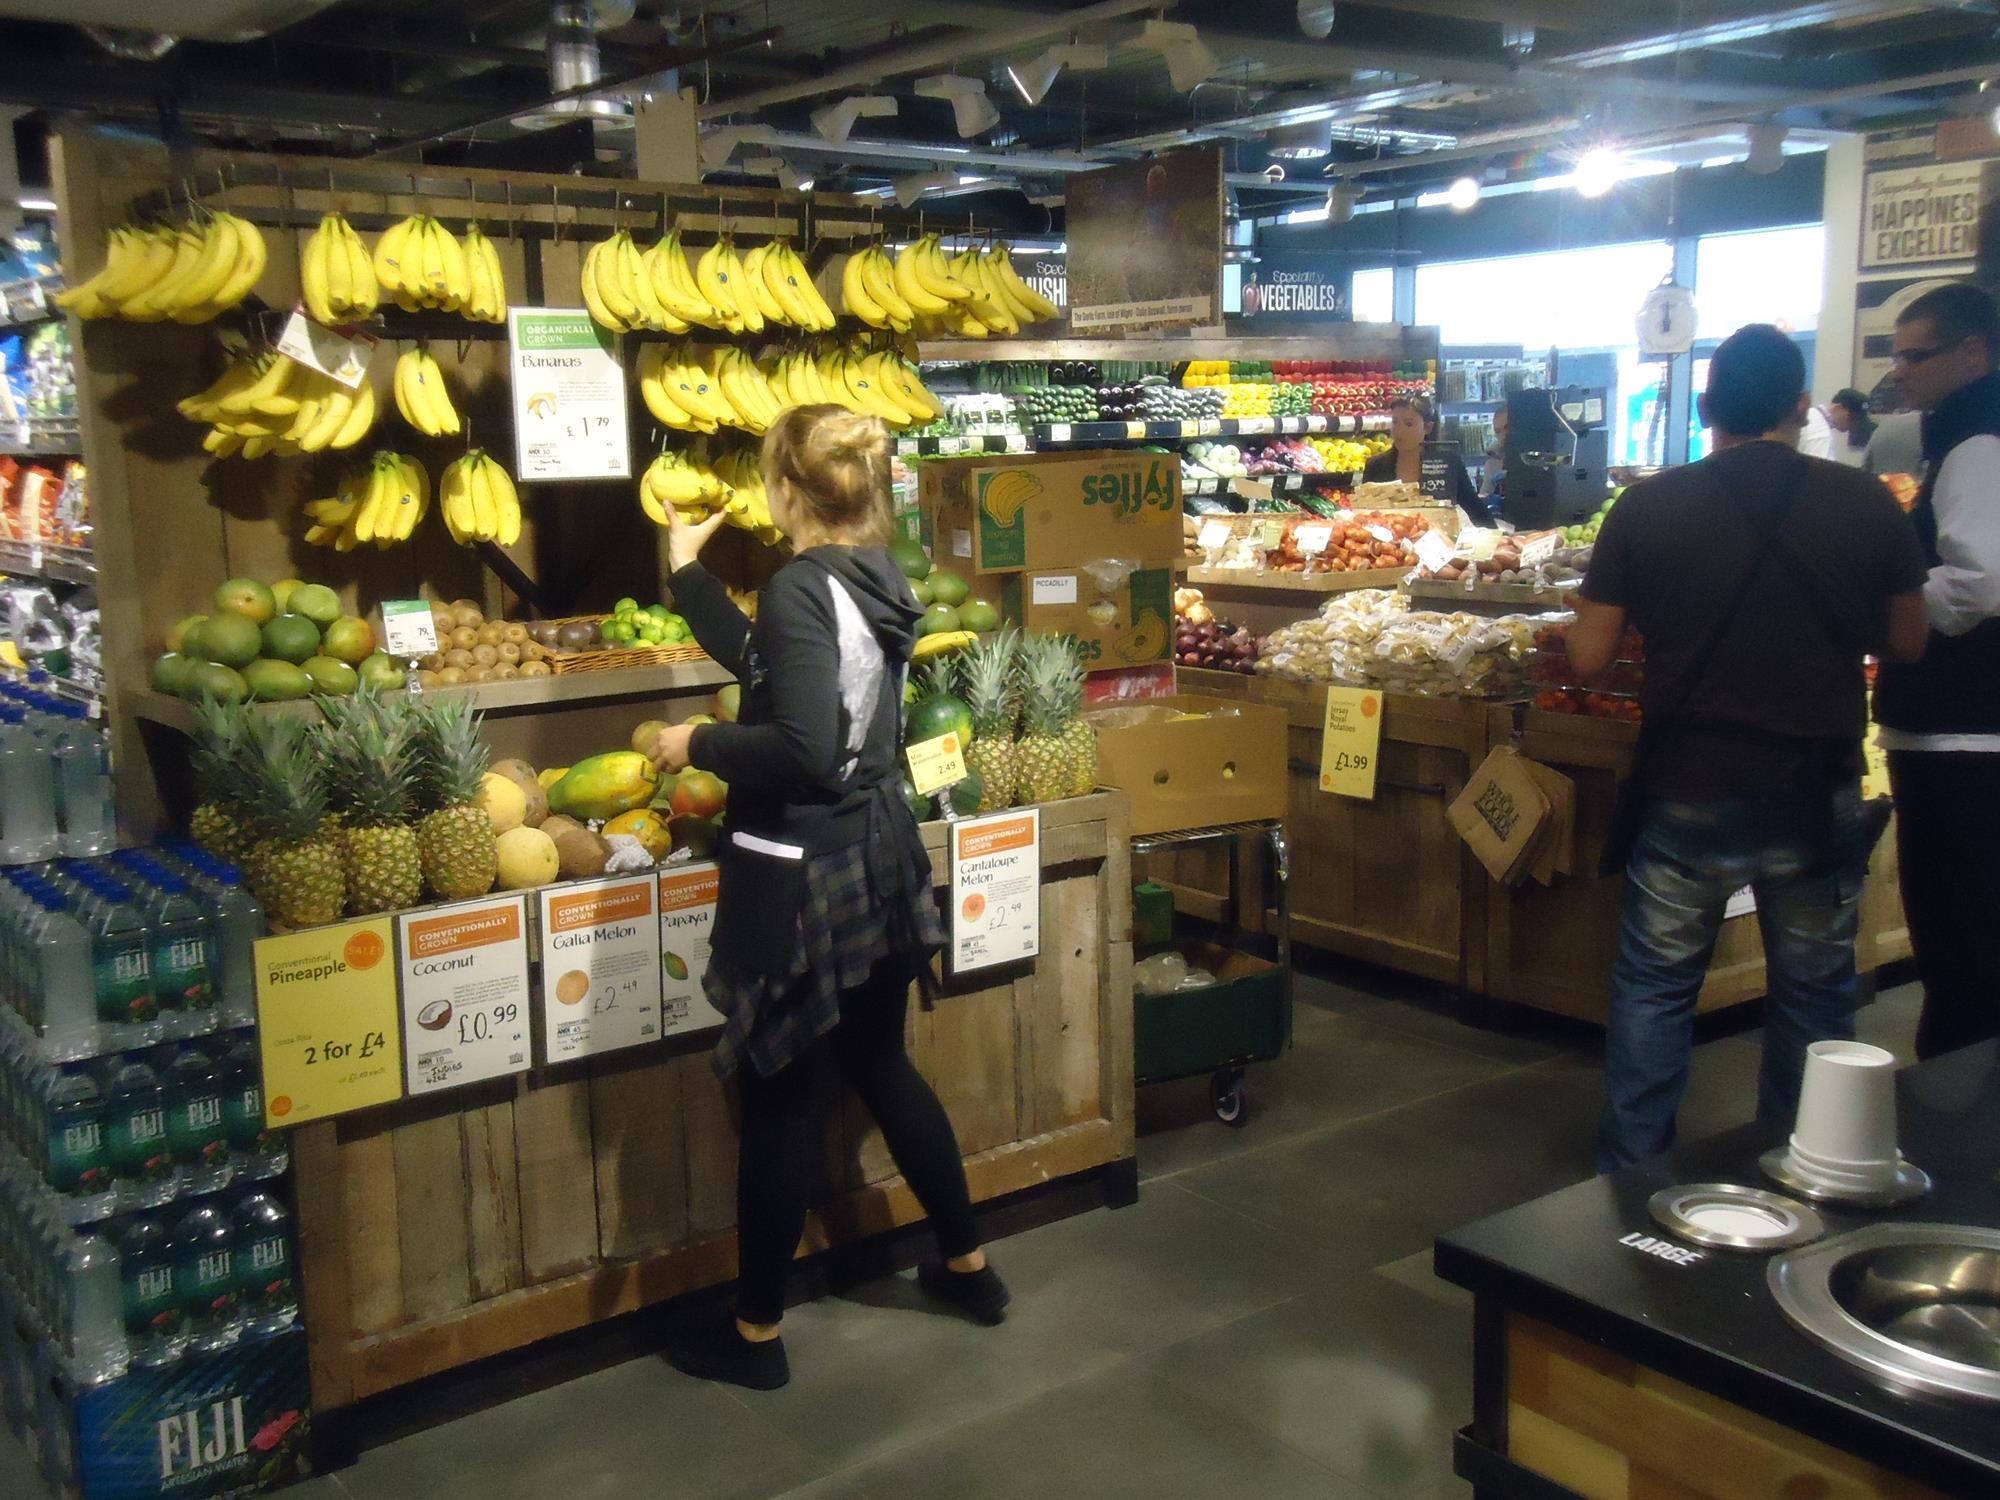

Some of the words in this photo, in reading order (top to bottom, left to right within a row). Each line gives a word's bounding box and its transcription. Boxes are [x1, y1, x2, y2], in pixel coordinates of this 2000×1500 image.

[1273, 270, 1325, 284] Speciality
[1260, 284, 1335, 311] VEGETABLES
[526, 325, 594, 334] ORGANICALLY
[526, 335, 563, 343] GROWN
[522, 355, 582, 368] Bananas
[1036, 579, 1069, 588] PICCADILLY
[1330, 705, 1349, 715] Jersey
[1330, 712, 1347, 723] Royal
[1329, 722, 1356, 733] Potatoes
[939, 761, 956, 774] 2.49
[1334, 752, 1368, 772] £1.99
[965, 826, 1026, 846] CONVENTIONALLY
[960, 856, 1019, 875] Cantaloupe
[961, 873, 994, 888] Melon
[559, 893, 641, 917] CONVENTIONALLY
[418, 916, 508, 942] CONVENTIONALLY
[559, 911, 594, 925] GROWN
[419, 935, 458, 951] GROWN
[553, 934, 591, 950] Galia
[594, 925, 636, 943] Melon
[115, 951, 149, 980] FIJI
[170, 941, 204, 968] FIJI
[268, 951, 332, 971] Conventional
[412, 954, 474, 977] Coconut
[269, 959, 347, 986] Pineapple
[458, 1003, 518, 1045] £0.99
[304, 1046, 318, 1065] 2
[322, 1040, 353, 1061] for
[358, 1031, 386, 1060] £4
[188, 1098, 221, 1126] FIJI
[65, 1122, 101, 1150] FIJI
[131, 1110, 165, 1140] FIJI
[252, 1238, 284, 1267] FIJI
[1619, 1232, 1704, 1266] LARGE
[199, 1252, 231, 1282] FIJI
[139, 1266, 173, 1297] FIJI
[158, 1395, 248, 1479] FIJI
